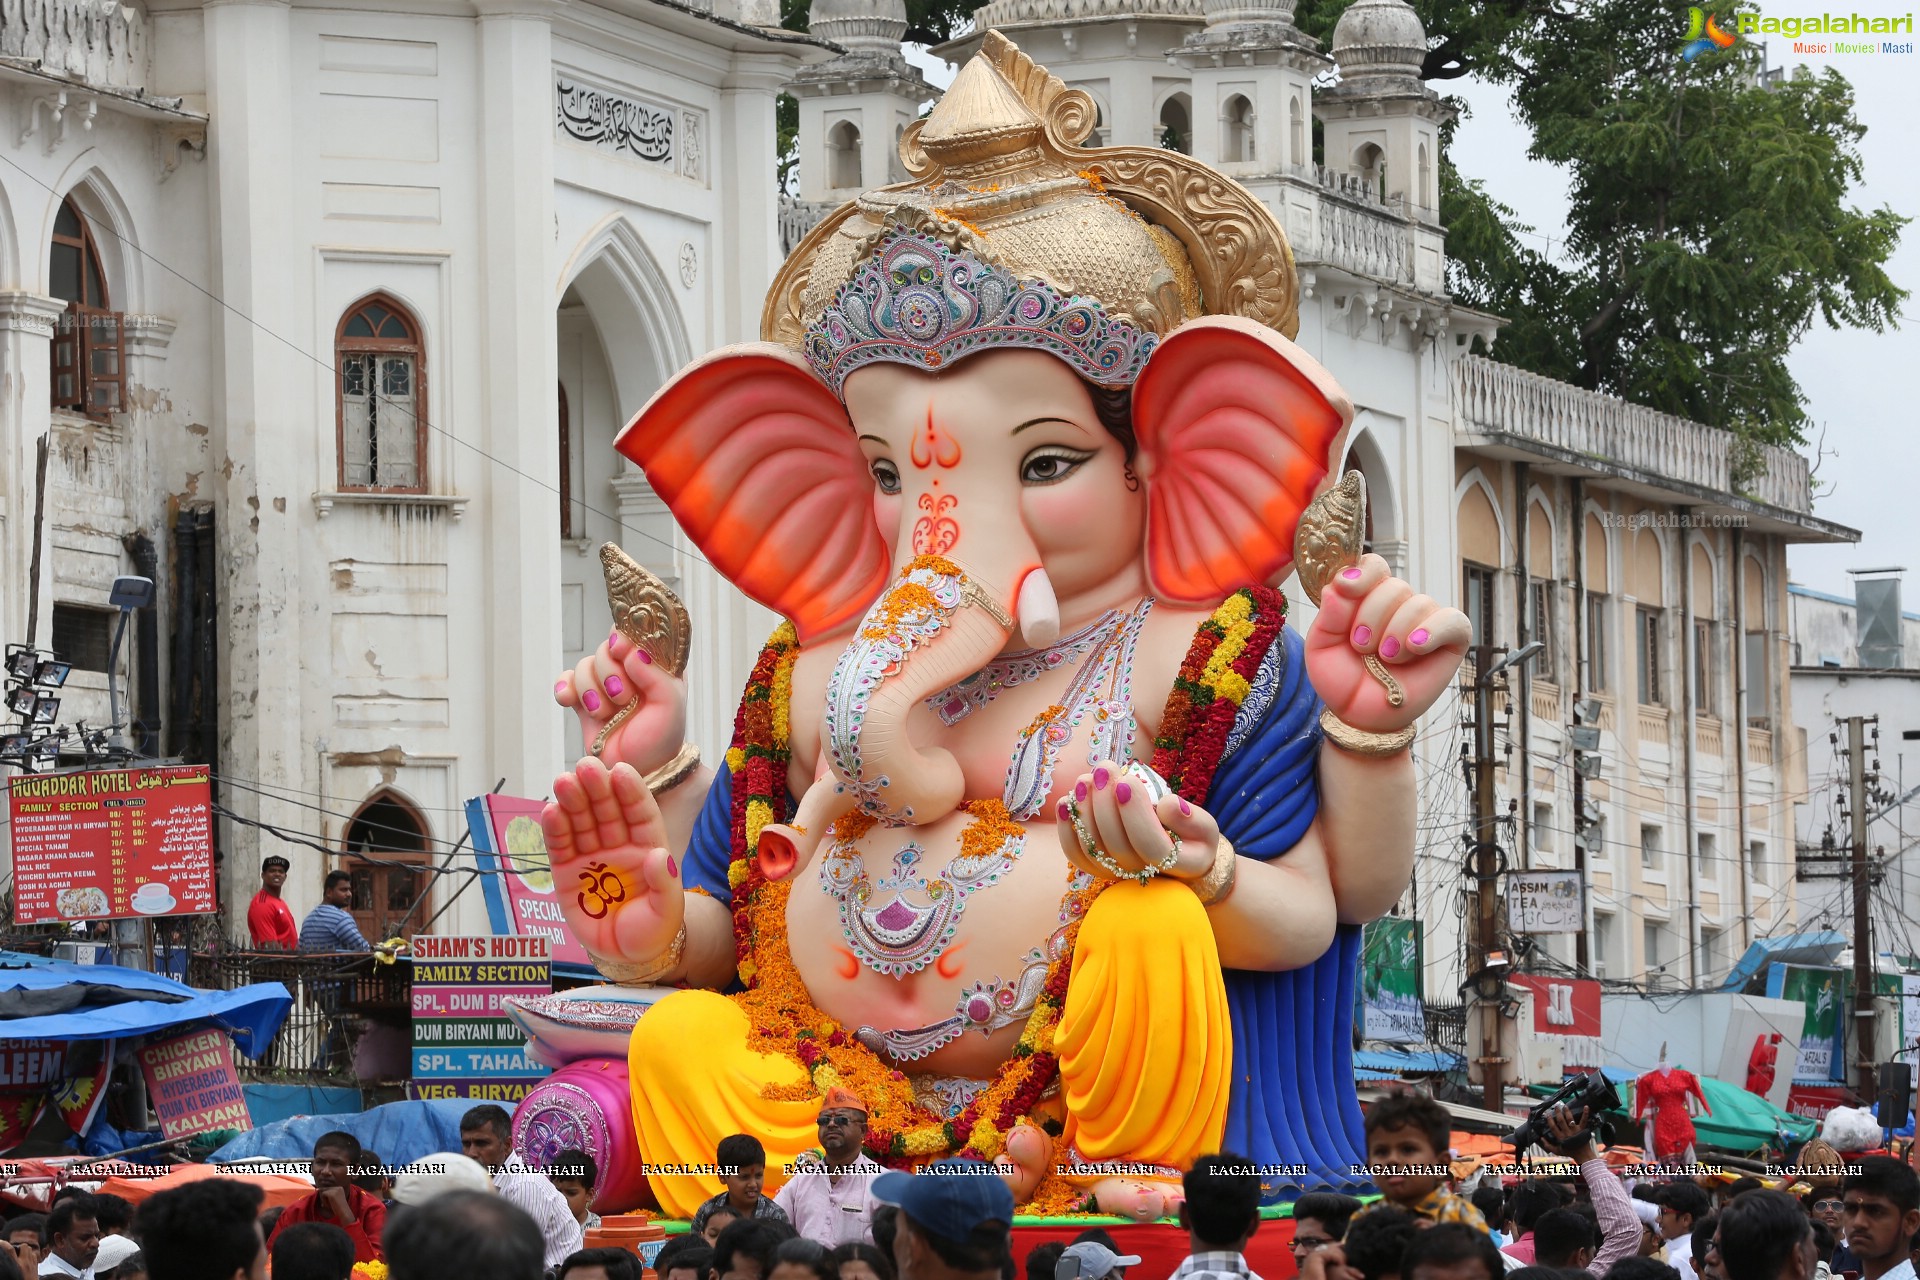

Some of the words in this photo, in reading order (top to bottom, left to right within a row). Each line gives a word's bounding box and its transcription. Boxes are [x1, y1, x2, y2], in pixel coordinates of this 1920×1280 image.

[12, 775, 87, 798] MUQADDAR
[91, 772, 132, 796] HOTEL
[20, 803, 53, 813] FAMILY
[59, 801, 99, 811] SECTION
[15, 816, 44, 824] CHICKEN
[45, 814, 72, 822] BIRYANI
[15, 826, 57, 834] HYDERABADI
[83, 821, 109, 829] BIRYANI
[45, 833, 71, 841] BIRYANI
[44, 852, 67, 860] KHANA
[1511, 882, 1549, 893] ASSAM
[19, 892, 45, 900] AAMLET
[1511, 897, 1538, 908] TEA
[519, 898, 566, 922] SPECIAL
[413, 938, 486, 957] SHAM'S
[491, 938, 548, 957] HOTEL
[413, 965, 473, 981] FAMILY
[477, 965, 548, 981] SECTION
[450, 994, 484, 1010] DUM
[415, 1024, 441, 1040] DUM
[445, 1024, 493, 1040] BIRYANI
[144, 1032, 221, 1065] CHICKEN
[153, 1050, 222, 1081] BIRYANI
[418, 1055, 462, 1070] SPL.
[160, 1068, 229, 1099] HYDERABADI
[159, 1102, 184, 1120] DUM
[185, 1096, 199, 1112] KI
[198, 1084, 242, 1109] BIRYANI
[165, 1103, 246, 1136] KALYANI
